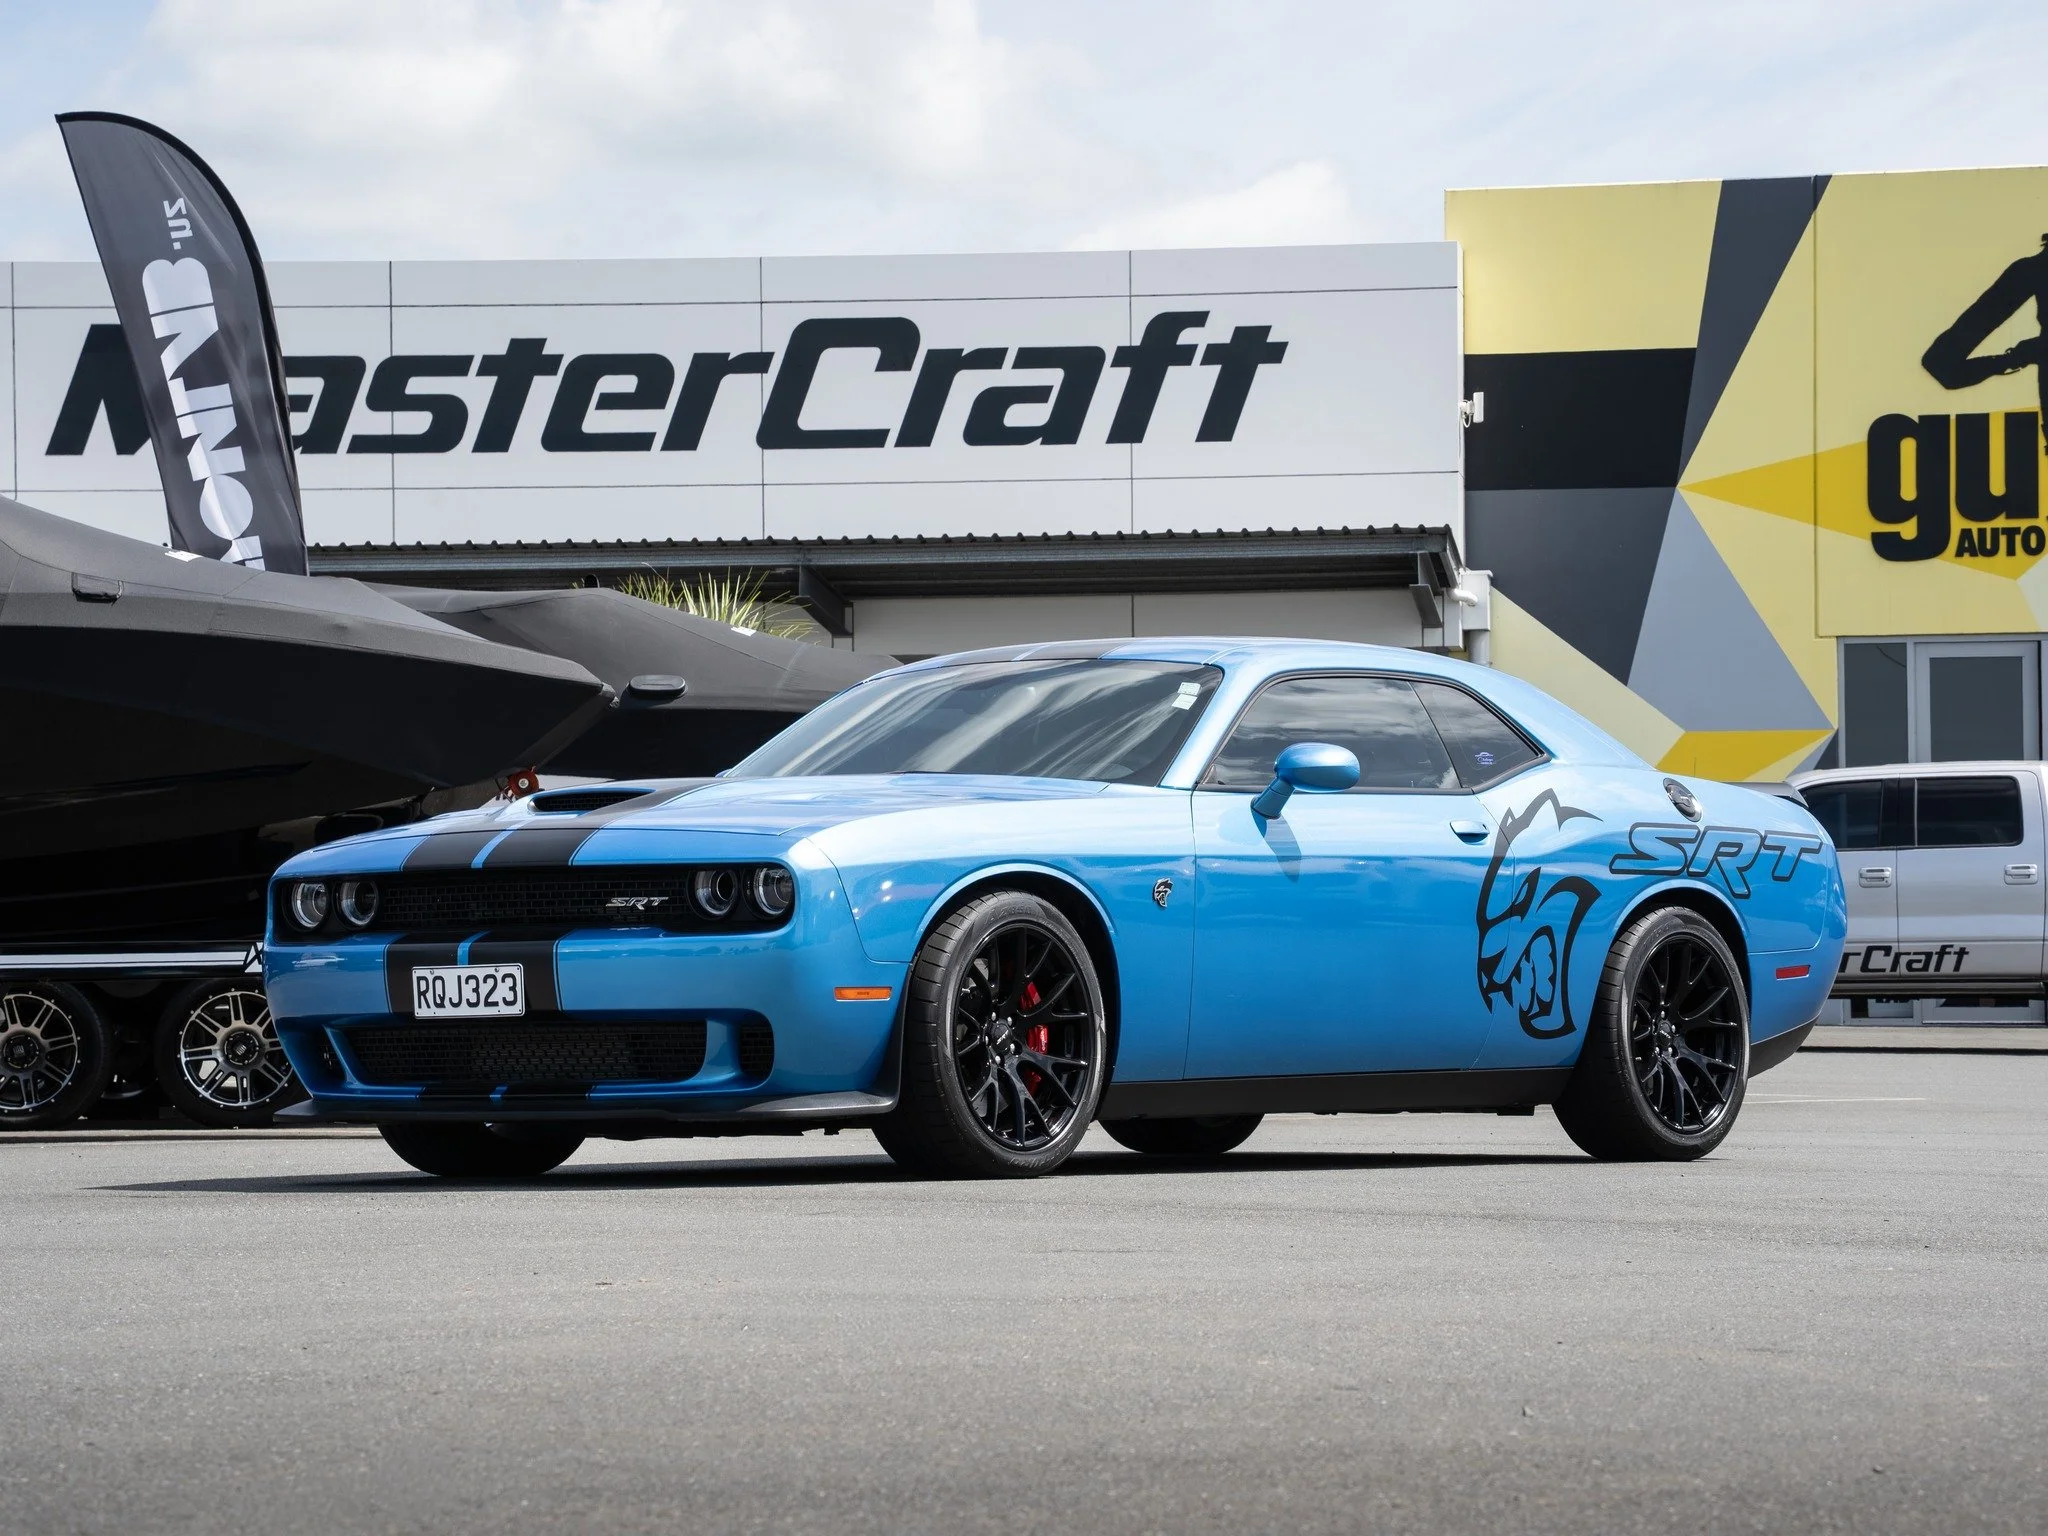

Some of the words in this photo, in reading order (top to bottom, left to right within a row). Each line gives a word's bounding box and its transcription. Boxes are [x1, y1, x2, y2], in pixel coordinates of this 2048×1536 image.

[45, 311, 1289, 455] MasterCraft
[1867, 411, 2048, 561] gu
[1955, 524, 2047, 558] AUTO
[1609, 822, 1823, 899] SRT
[605, 896, 669, 910] SRT
[416, 973, 518, 1009] RQJ323
